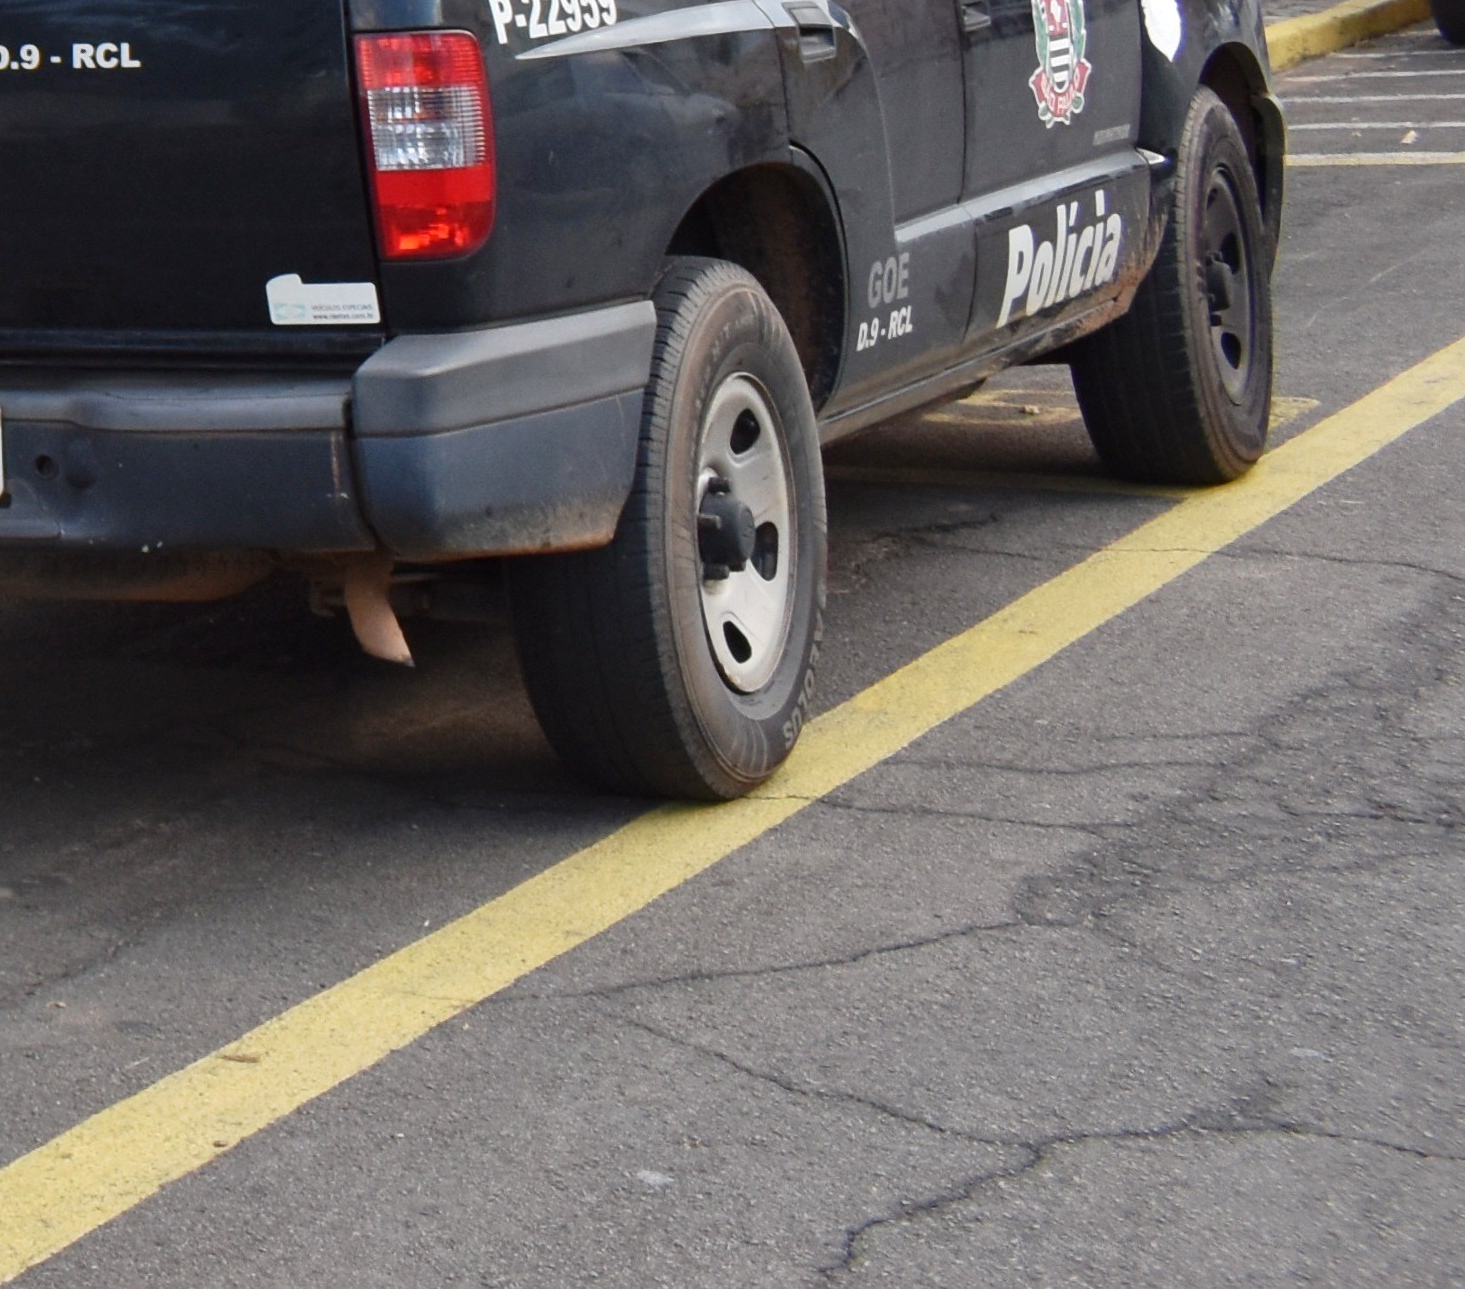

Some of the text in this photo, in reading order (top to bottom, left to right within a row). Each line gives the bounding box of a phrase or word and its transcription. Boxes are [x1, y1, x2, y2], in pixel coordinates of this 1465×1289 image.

[72, 43, 141, 69] RCL
[867, 252, 910, 310] GOE
[995, 188, 1122, 330] Polícia
[856, 317, 879, 352] D.9
[887, 305, 913, 341] RCL
